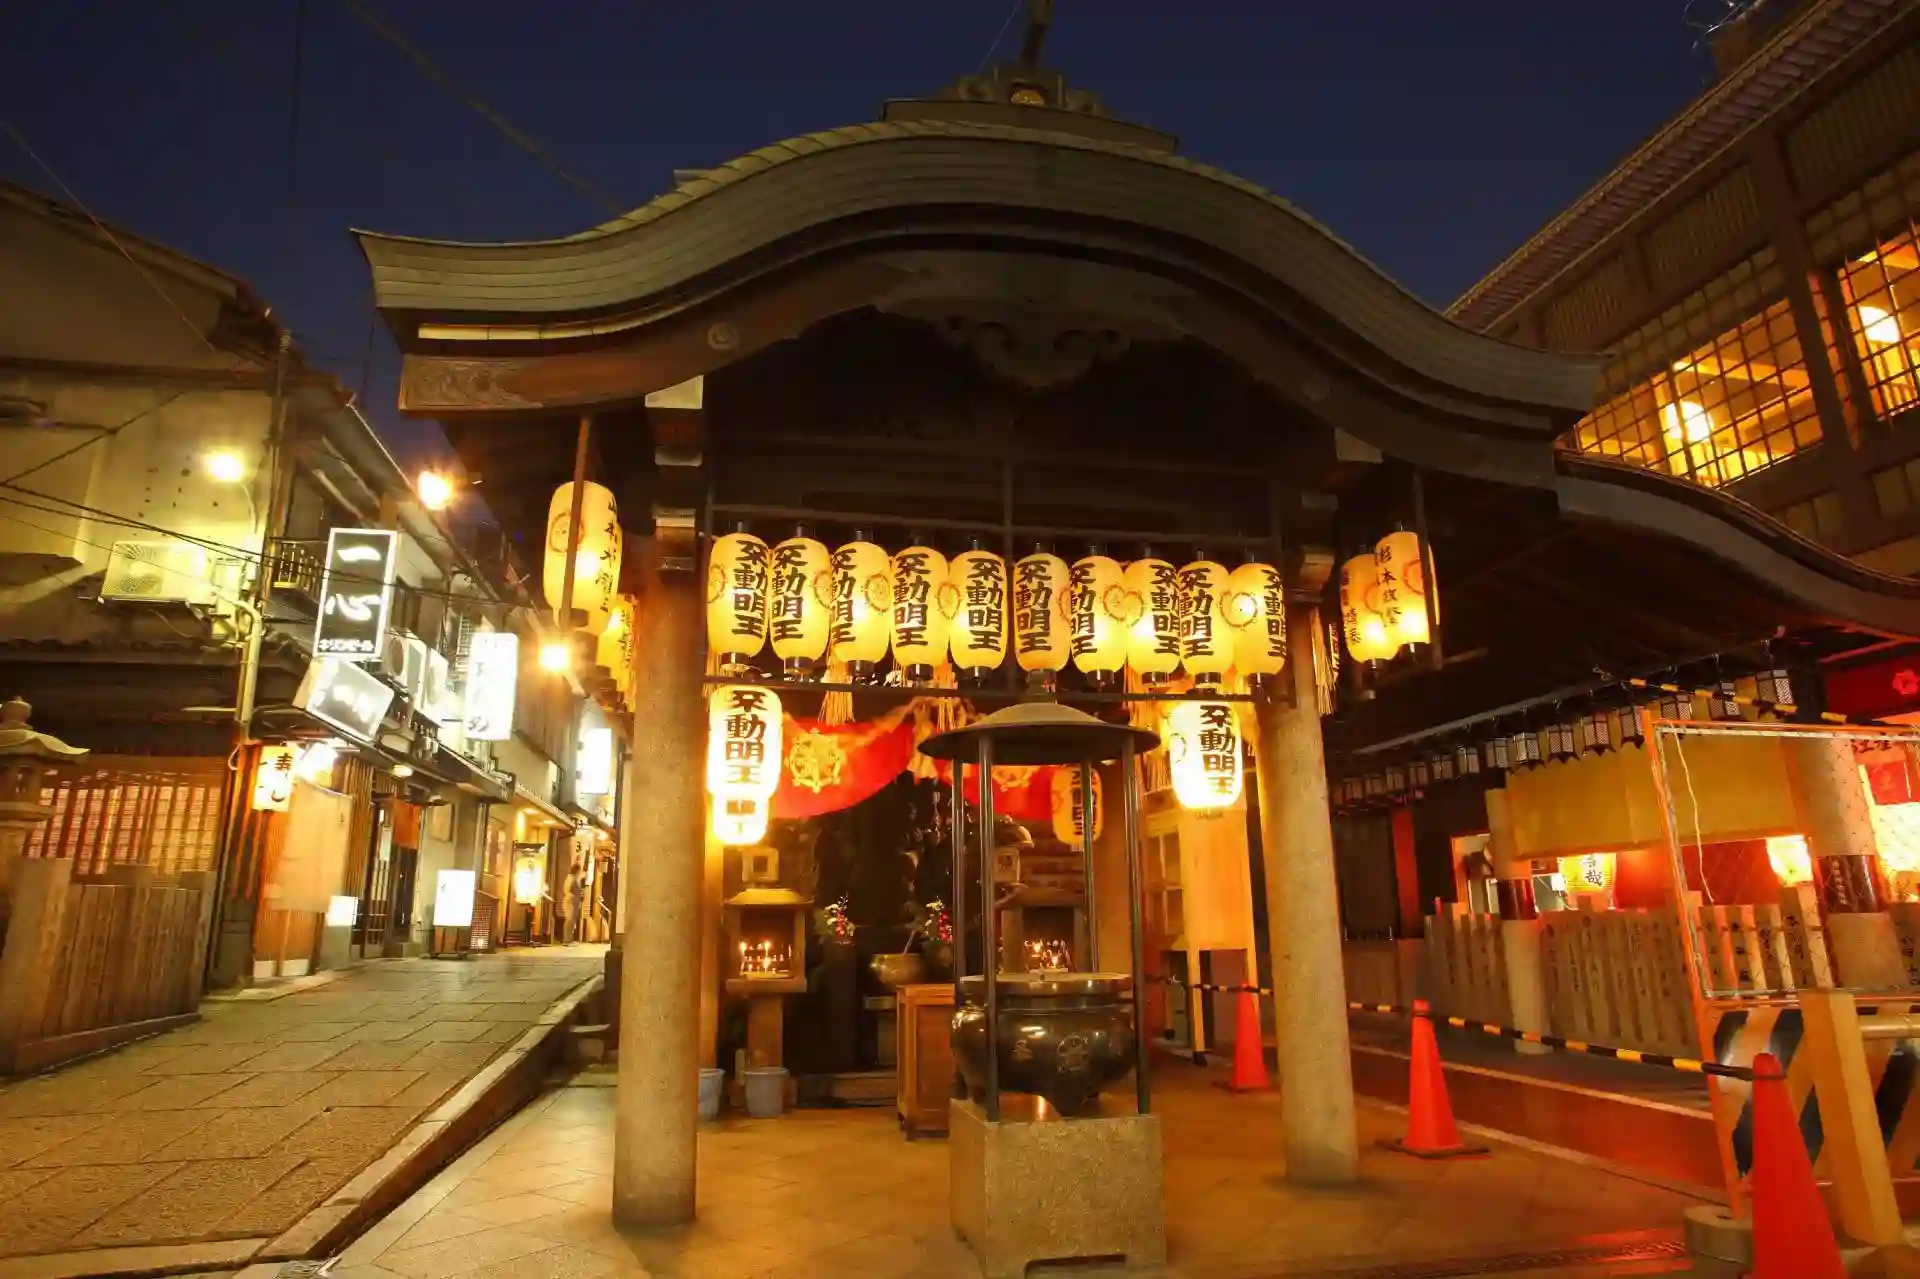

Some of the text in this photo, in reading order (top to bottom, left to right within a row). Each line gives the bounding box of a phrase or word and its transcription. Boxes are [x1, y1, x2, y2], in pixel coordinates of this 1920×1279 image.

[732, 540, 768, 639] 不動明王
[771, 545, 808, 642] 不動明王
[893, 553, 932, 648] 不動明王
[966, 558, 1004, 652] 不動明王
[1015, 560, 1052, 653] 不動明王
[1149, 564, 1180, 655] 不動明王
[1179, 568, 1213, 659] 不動明王
[724, 690, 767, 783] 不動明王
[1199, 705, 1235, 793] 不動明王
